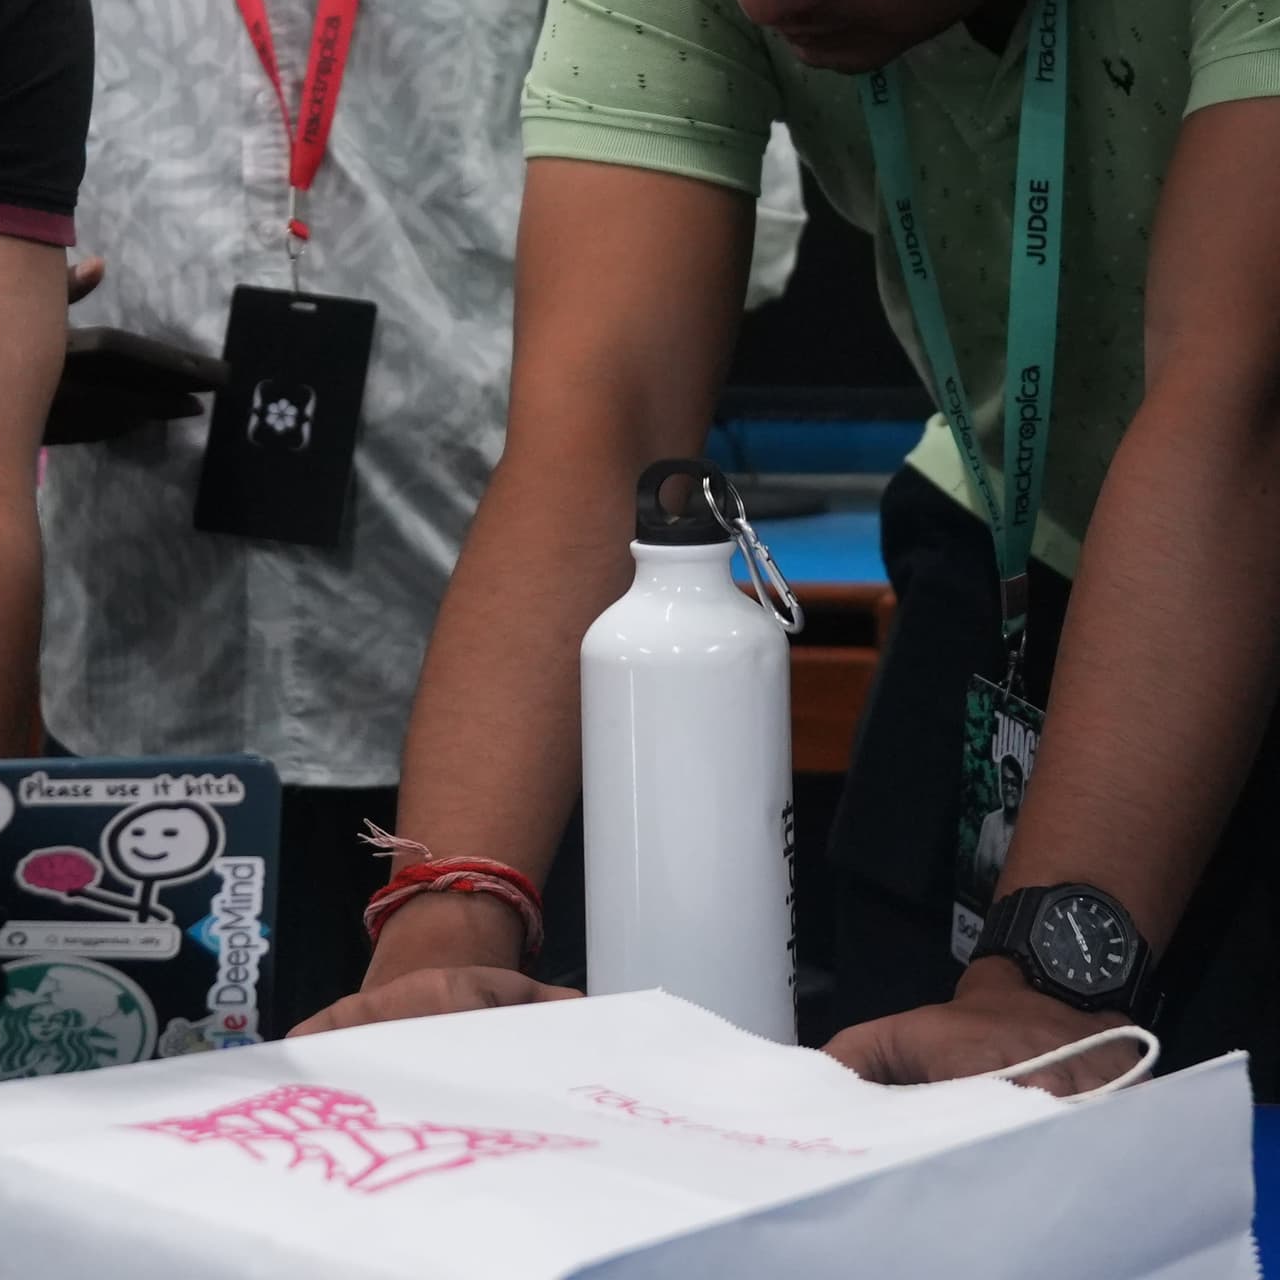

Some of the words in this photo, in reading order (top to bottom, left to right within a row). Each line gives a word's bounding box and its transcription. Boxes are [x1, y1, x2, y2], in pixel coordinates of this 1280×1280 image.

[896, 197, 927, 280] JUDGE
[1025, 179, 1050, 266] JUDGE
[1012, 364, 1043, 527] hacktropica
[105, 783, 141, 799] use
[153, 777, 172, 797] it
[184, 775, 242, 798] bitch
[215, 861, 259, 1006] DeepMind
